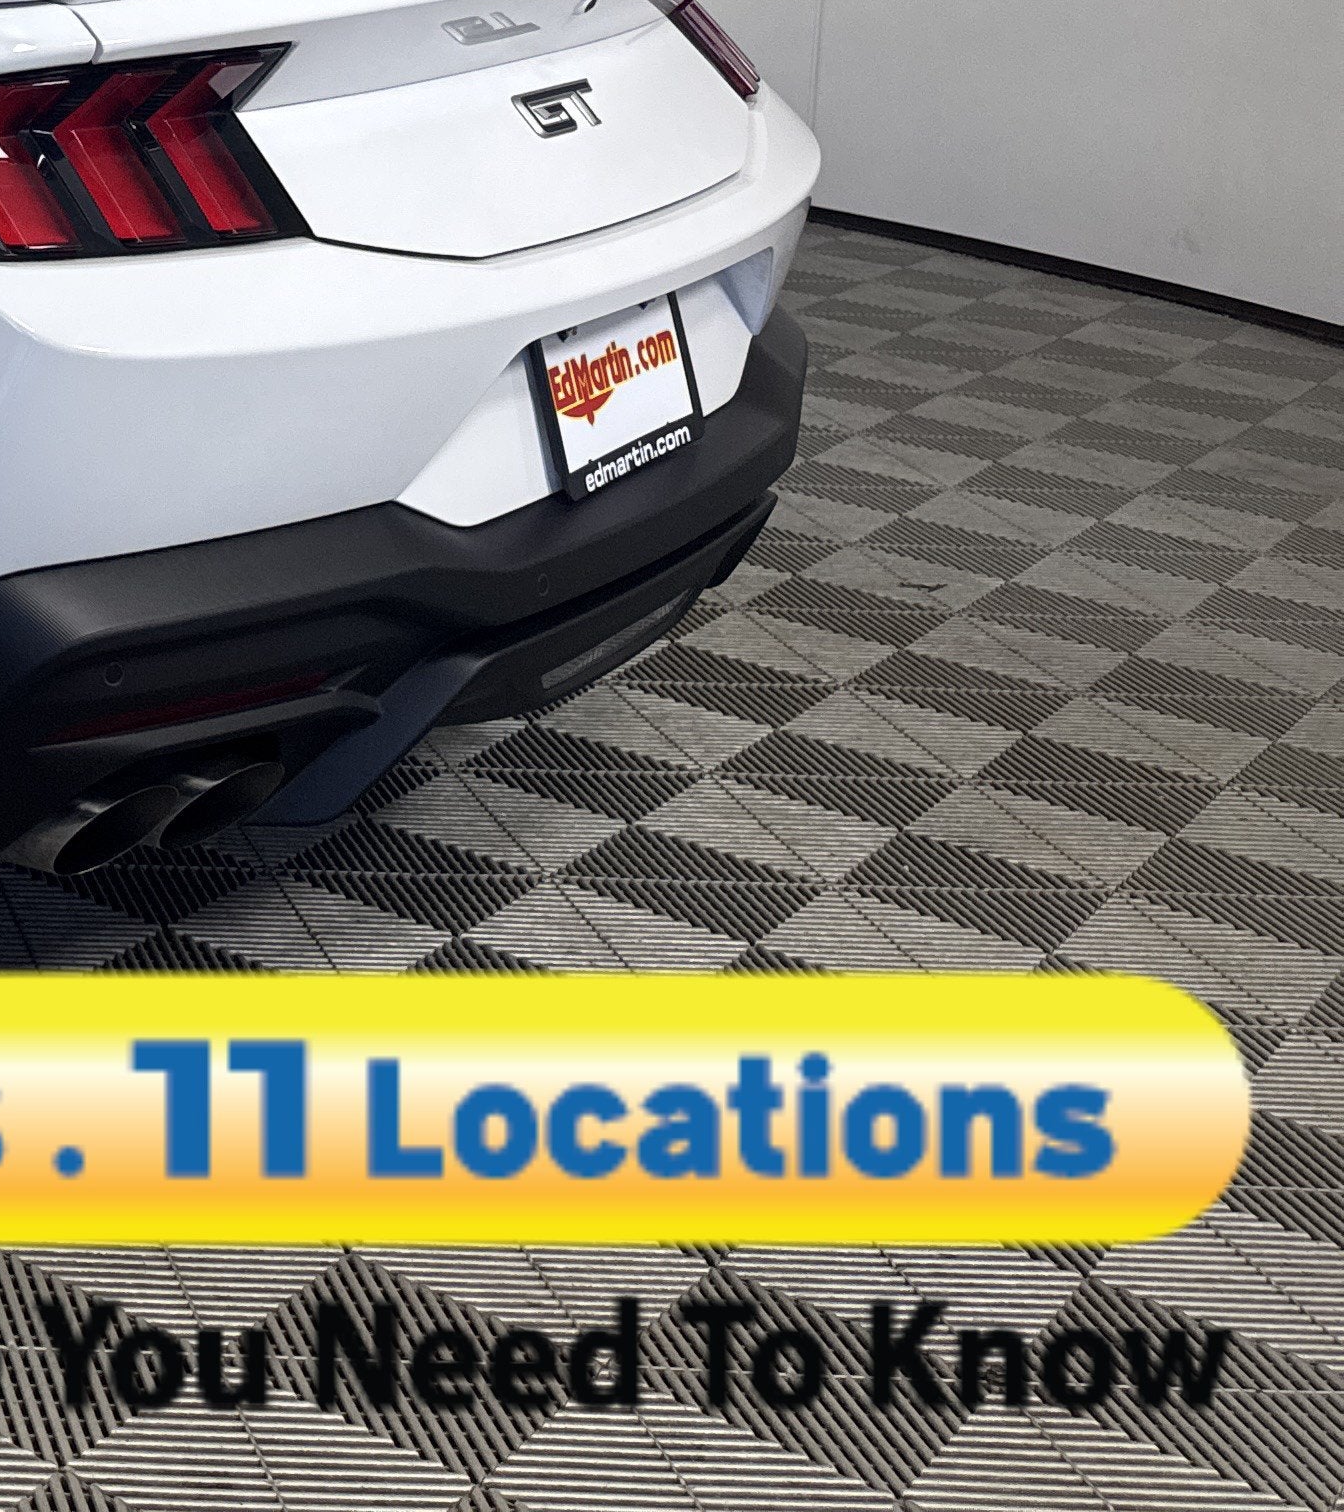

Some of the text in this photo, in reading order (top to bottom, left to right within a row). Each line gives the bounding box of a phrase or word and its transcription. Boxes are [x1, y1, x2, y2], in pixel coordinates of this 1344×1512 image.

[511, 78, 602, 138] GT
[547, 329, 678, 412] EdMartin.com
[585, 425, 692, 492] edmartin.com
